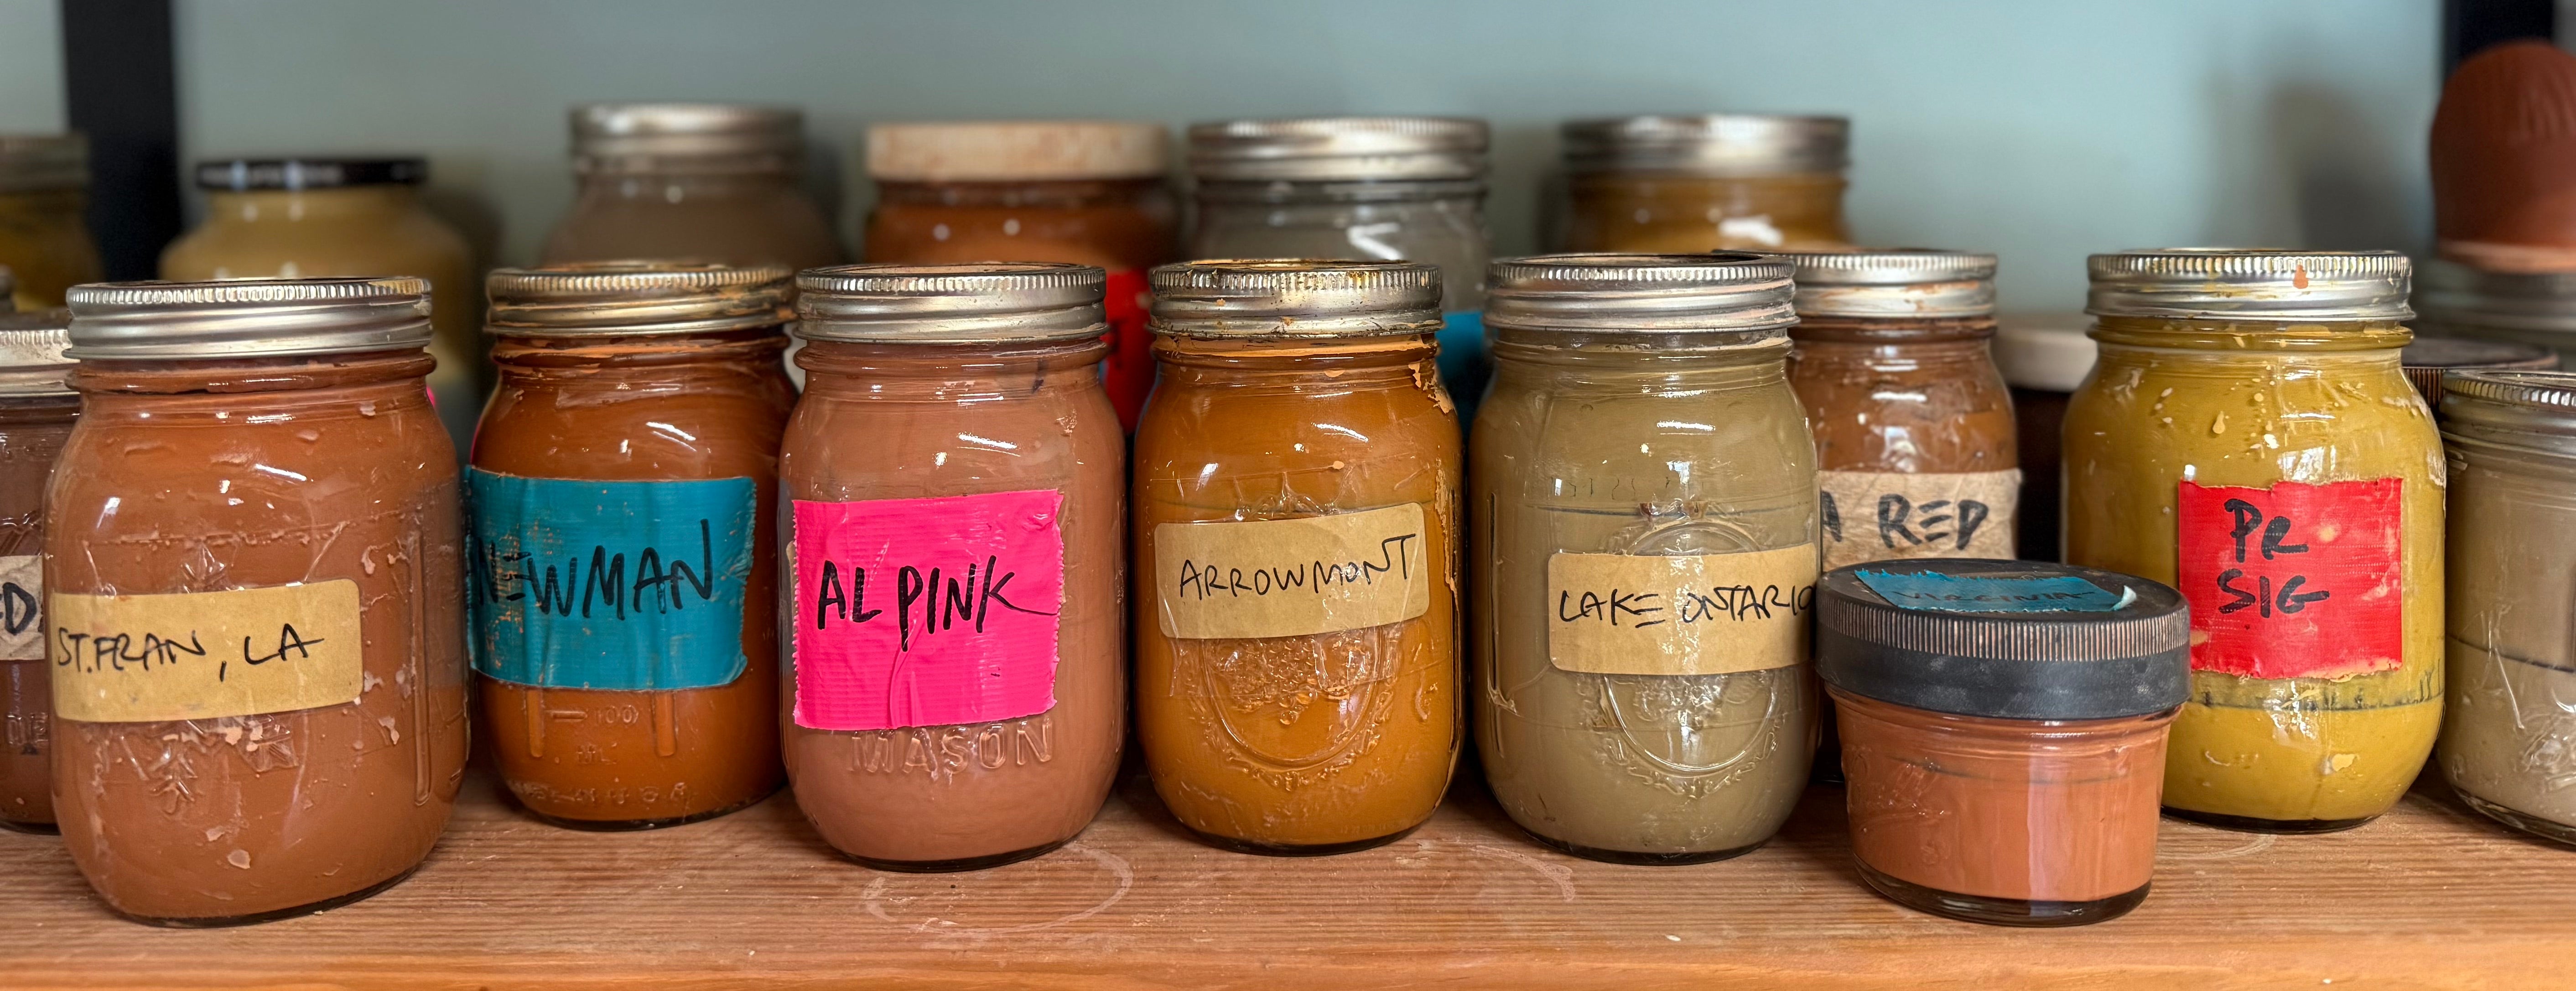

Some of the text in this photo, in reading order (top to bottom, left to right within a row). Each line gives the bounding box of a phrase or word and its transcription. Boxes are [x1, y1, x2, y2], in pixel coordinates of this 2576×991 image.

[1877, 493, 1989, 550] RED
[2224, 498, 2308, 563] PR
[475, 519, 713, 620] NEWMAN
[1180, 533, 1416, 600] ARROWMONT
[2213, 568, 2330, 618] SIG
[818, 555, 1059, 651] AL PINK
[1559, 584, 1816, 628] LAKE ONTARIO
[244, 623, 325, 661] LA
[850, 717, 1052, 774] MASON
